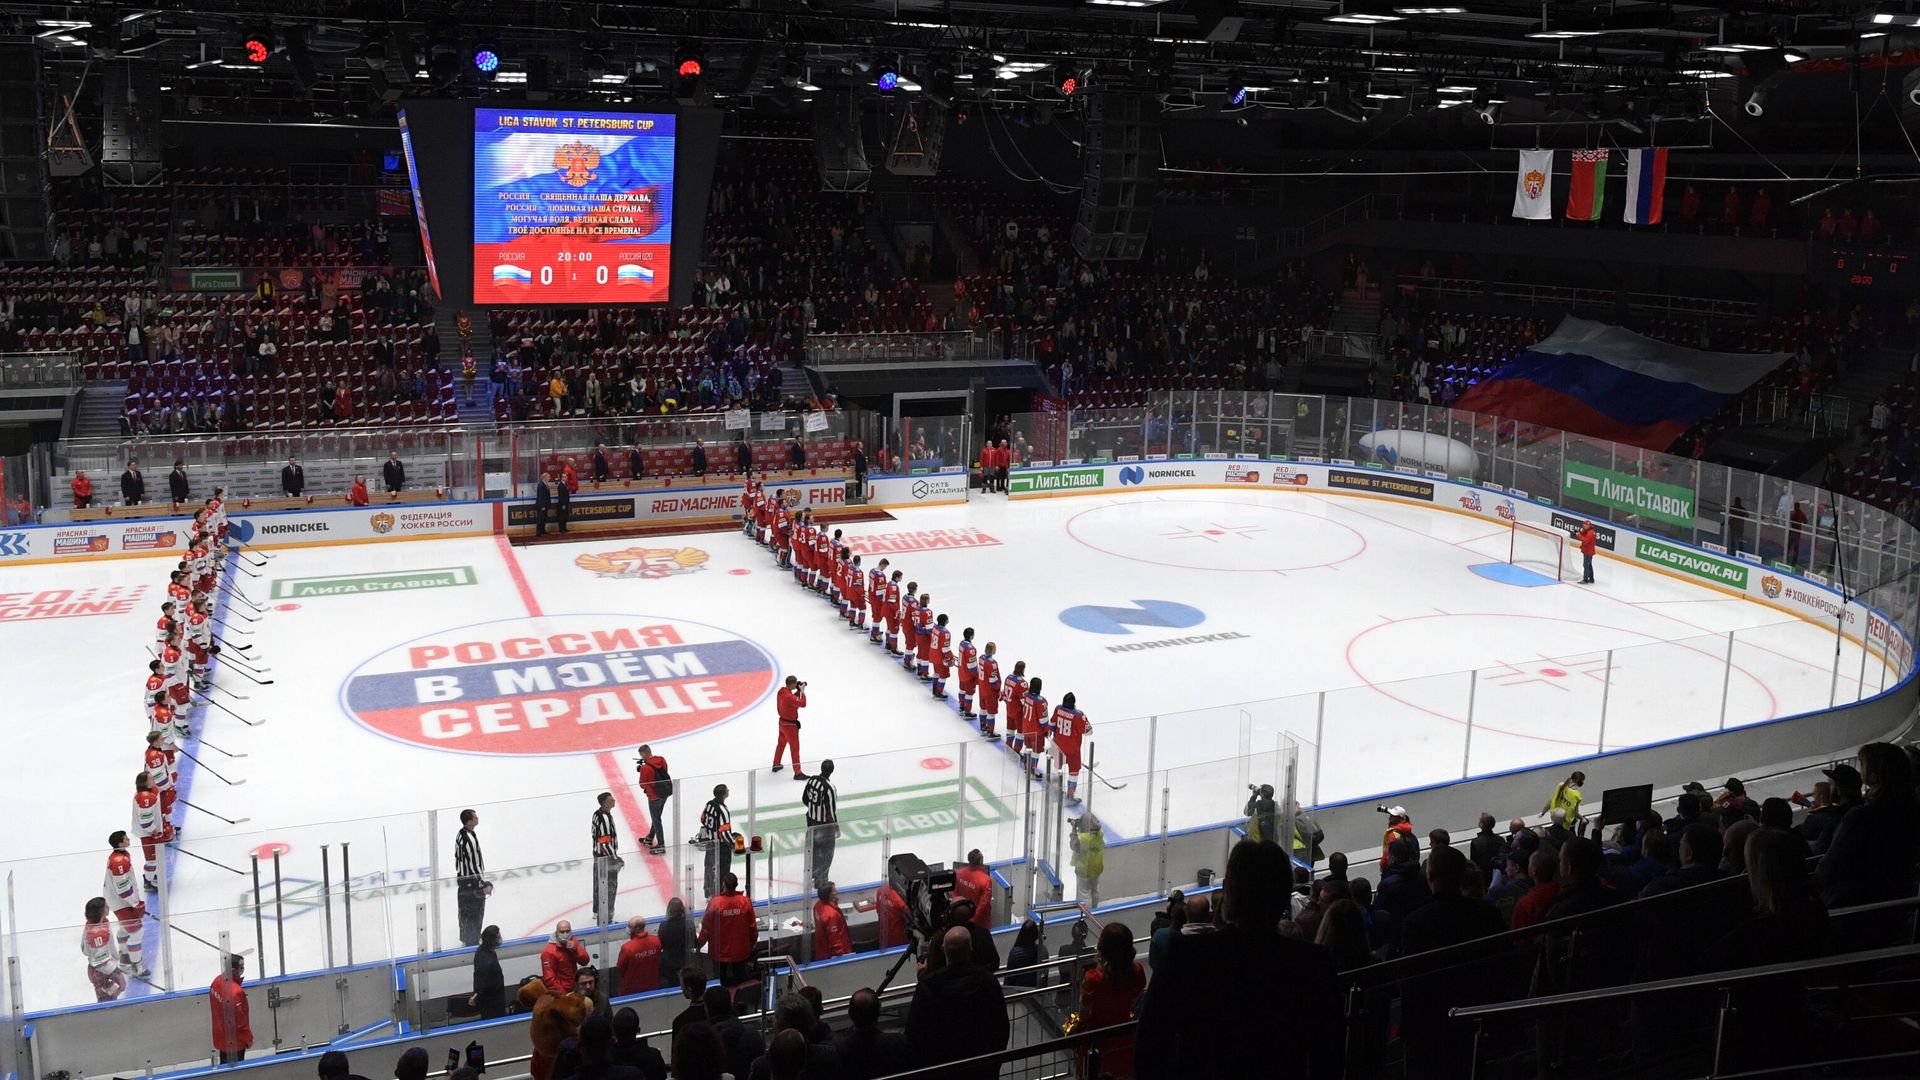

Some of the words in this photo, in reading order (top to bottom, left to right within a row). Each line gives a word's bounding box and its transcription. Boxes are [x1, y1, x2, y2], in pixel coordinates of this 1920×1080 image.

[499, 116, 519, 126] LIGA
[523, 117, 558, 127] STAVOK
[577, 118, 634, 129] PETERSBURG
[636, 120, 654, 129] CUP
[558, 253, 592, 261] 20:00
[541, 266, 552, 285] 0
[597, 265, 608, 285] 0
[1401, 456, 1445, 472] NORNCKEL
[1149, 469, 1196, 478] NORNICKEL
[1331, 475, 1344, 483] LIGA
[1346, 476, 1369, 486] STAVOK
[1420, 487, 1431, 495] CUP
[651, 499, 677, 513] RED
[680, 495, 738, 511] MACHINE
[400, 512, 452, 521] ФЕДЕРАЦИЯ
[400, 521, 435, 530] ХОККЕЯ
[437, 519, 473, 528] РОССИИ
[261, 522, 329, 534] NORNICKEL
[1640, 544, 1743, 582] LIGASTAVOK.RU
[409, 624, 685, 669] РОССИЯ
[1104, 631, 1251, 653] NORNICKEL
[414, 674, 464, 703] В
[495, 652, 709, 695] МОЁМ
[419, 680, 733, 739] СЕРДЦЕ
